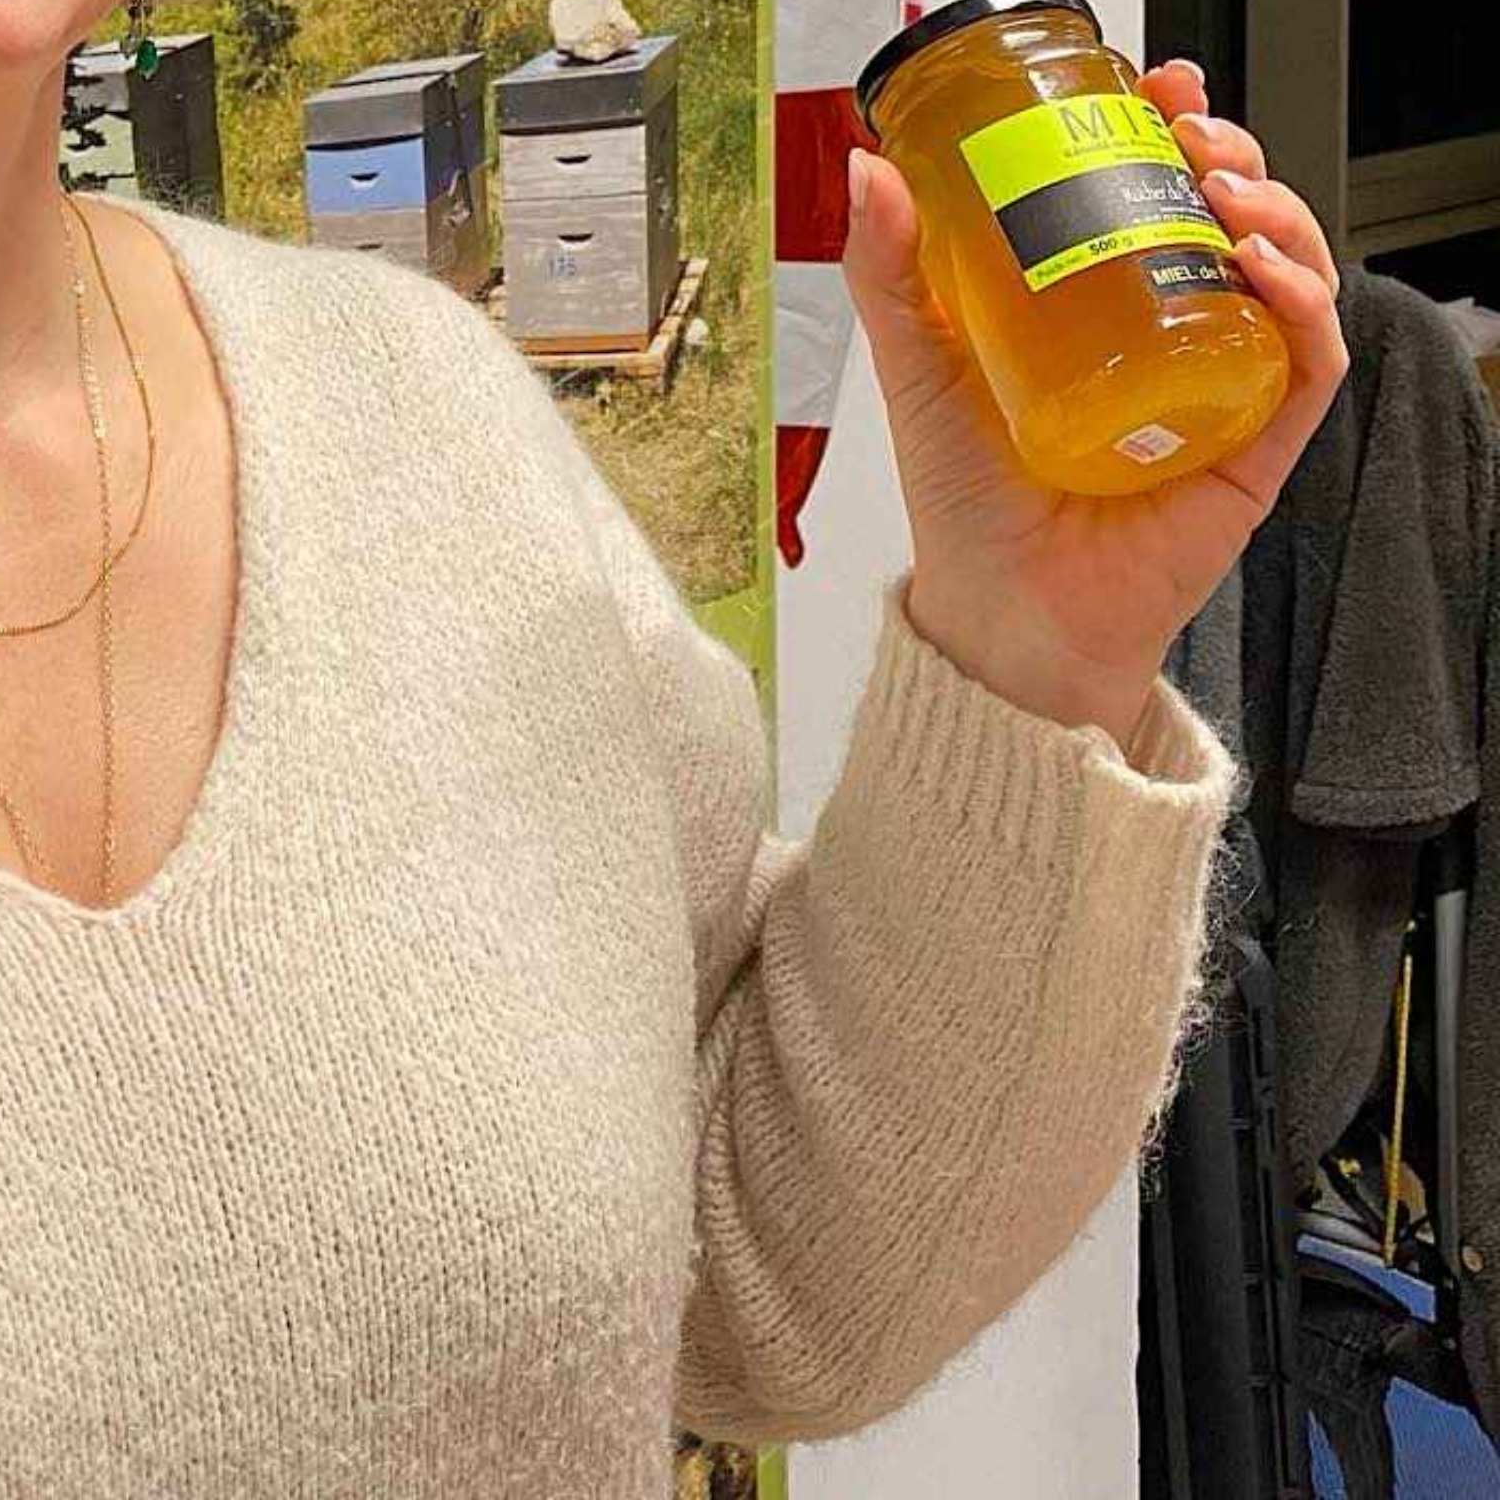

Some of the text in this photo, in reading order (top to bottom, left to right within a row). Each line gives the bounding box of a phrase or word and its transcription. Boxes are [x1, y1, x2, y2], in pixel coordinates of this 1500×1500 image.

[1088, 237, 1118, 257] 500
[1151, 265, 1198, 287] MIEL
[1199, 264, 1220, 281] de
